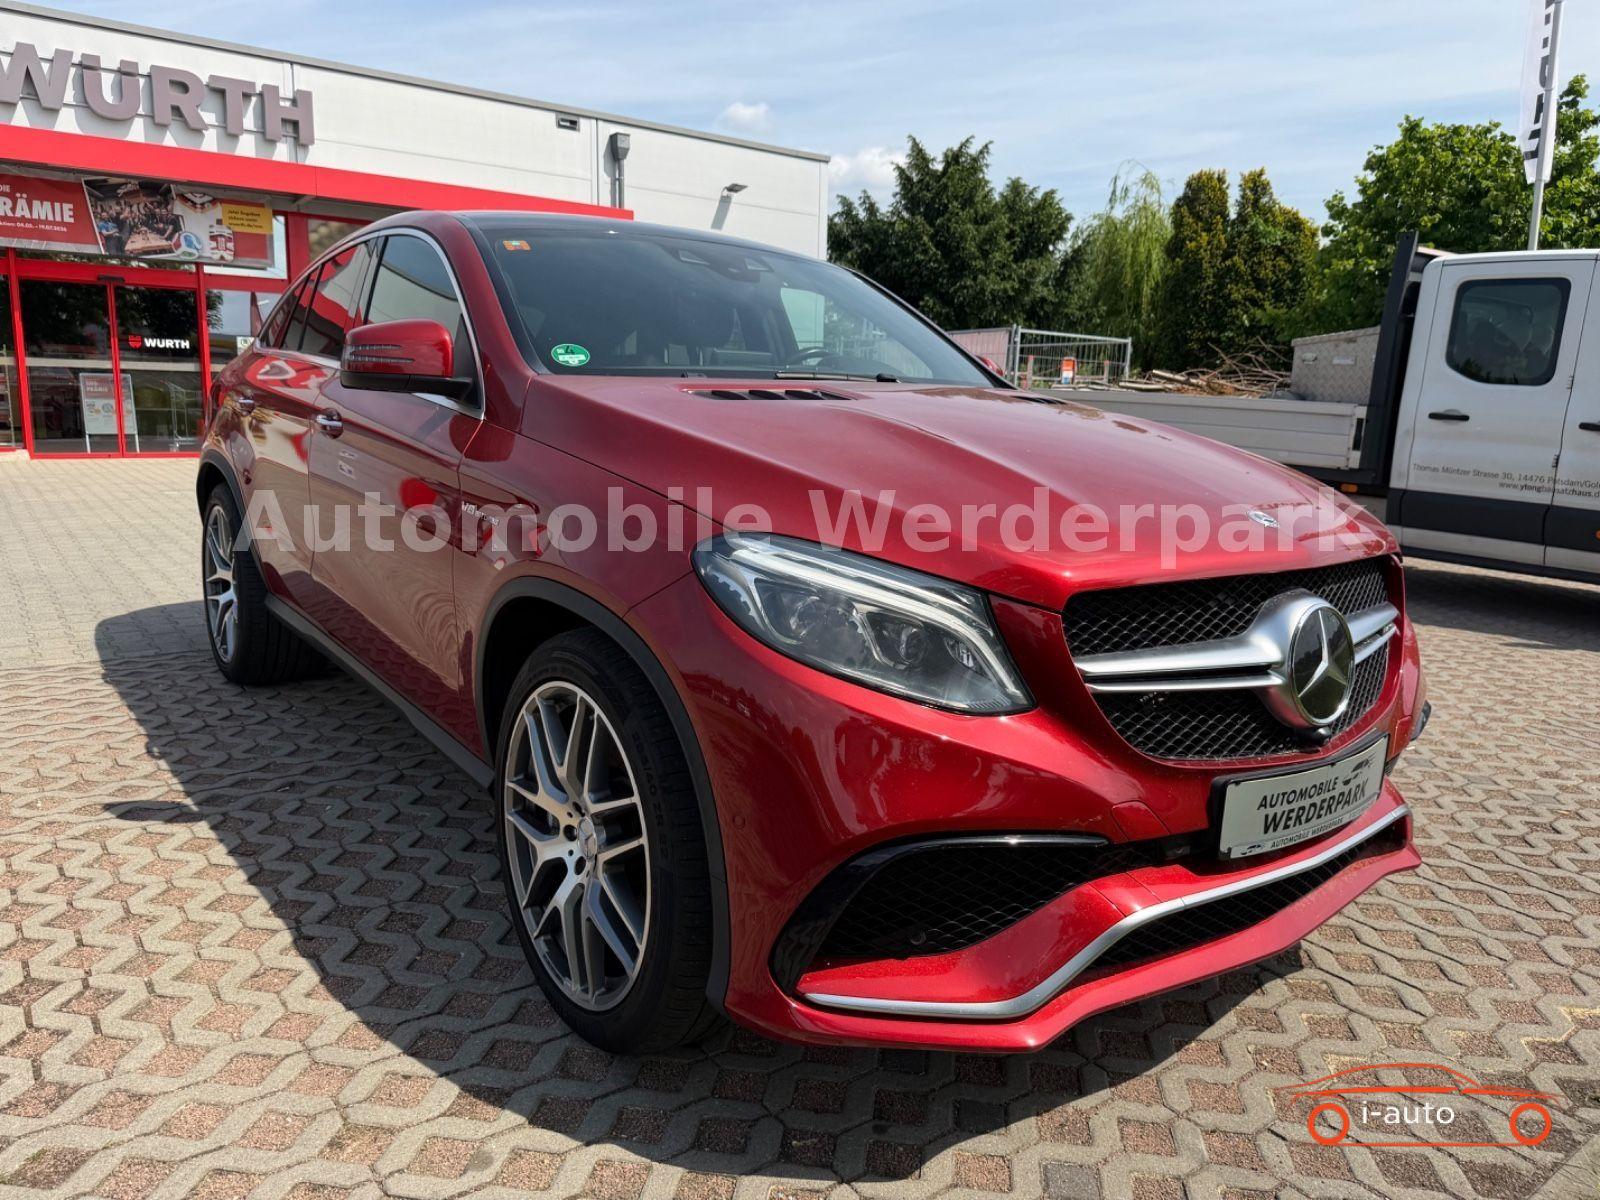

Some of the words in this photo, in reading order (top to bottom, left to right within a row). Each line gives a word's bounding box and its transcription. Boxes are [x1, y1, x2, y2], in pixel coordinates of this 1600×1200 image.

[0, 193, 74, 223] RÄMIE
[1413, 463, 1440, 472] Thomas
[1440, 465, 1471, 476] Müntzer
[1472, 469, 1500, 478] Strasse
[1518, 474, 1545, 483] 14476
[1547, 477, 1600, 489] Ptsdam/Gol
[1257, 777, 1338, 810] AUTOMOBILE
[1263, 778, 1369, 834] WERDERPARK
